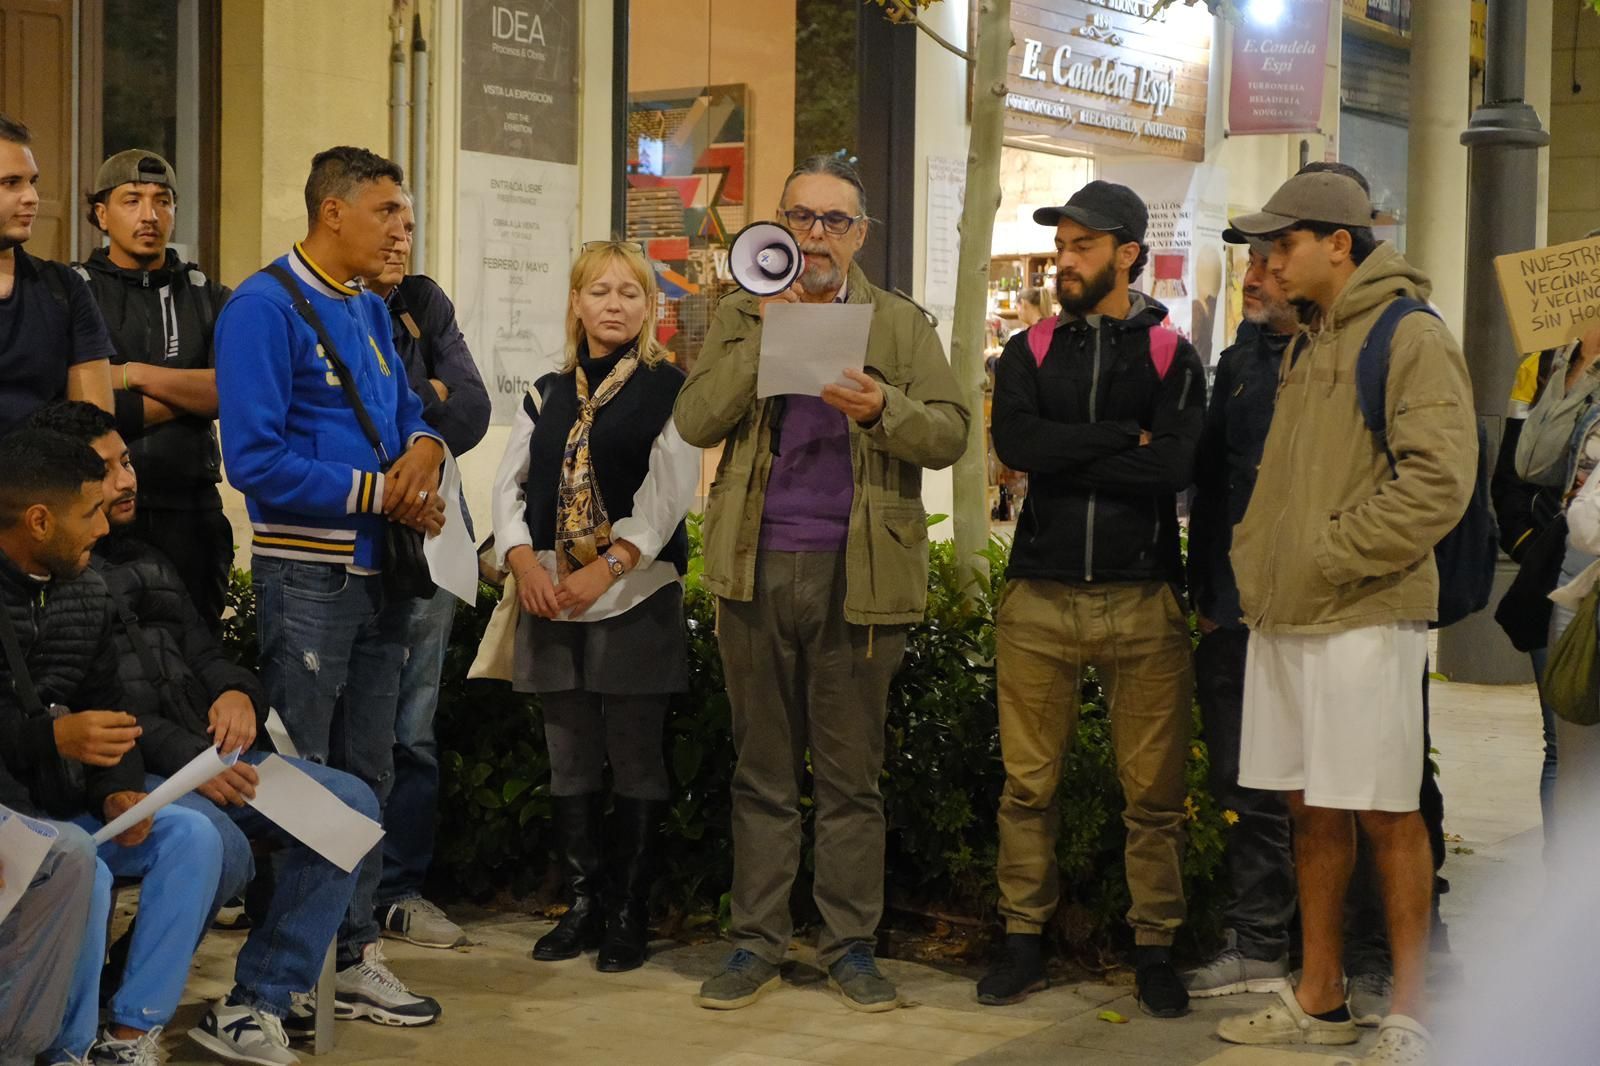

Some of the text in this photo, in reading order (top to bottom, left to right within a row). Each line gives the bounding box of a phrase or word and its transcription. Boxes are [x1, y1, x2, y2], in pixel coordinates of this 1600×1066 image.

[492, 6, 546, 47] IDEA
[1260, 39, 1316, 54] Candela
[1020, 38, 1047, 82] E.
[1053, 45, 1131, 99] Candela
[1144, 121, 1187, 141] NOUGATS
[490, 178, 523, 192] ENTRADA
[483, 256, 519, 271] FEBRERO
[525, 261, 549, 273] MAYO
[1525, 267, 1600, 297] VECINAS
[1531, 298, 1540, 313] Y
[1531, 309, 1562, 332] SIN
